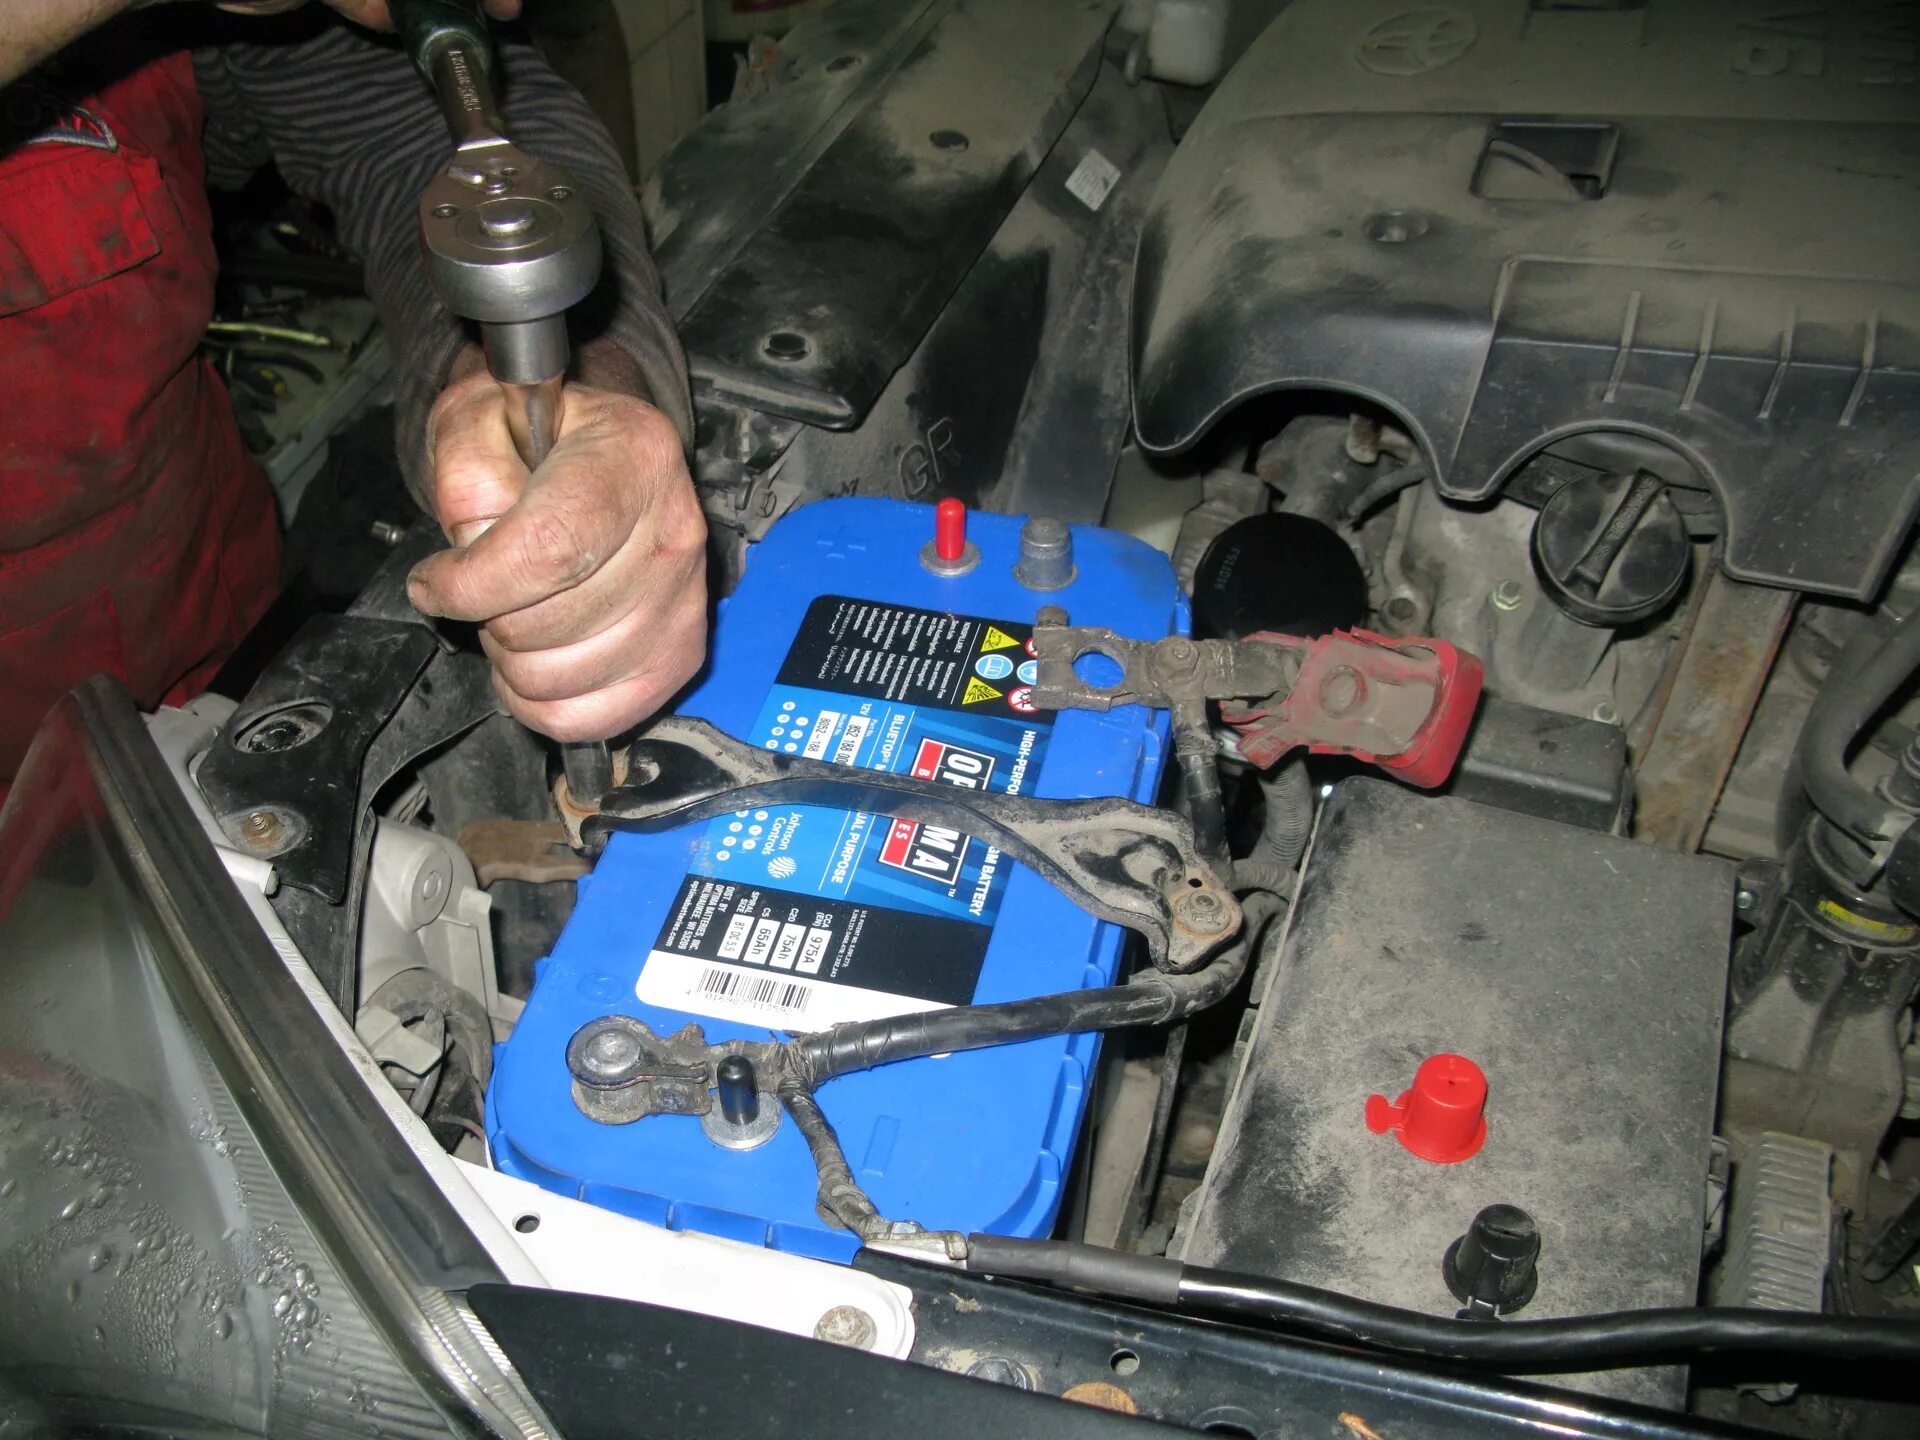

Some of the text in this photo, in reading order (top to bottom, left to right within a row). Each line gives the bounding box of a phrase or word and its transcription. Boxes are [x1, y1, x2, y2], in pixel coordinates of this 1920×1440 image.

[899, 417, 962, 500] GR
[859, 703, 871, 715] 12V
[815, 717, 830, 733] 8052
[845, 724, 861, 737] 852
[807, 741, 820, 751] 188
[839, 740, 854, 751] 188
[1006, 730, 1035, 794] HIGH-PERFO
[762, 817, 786, 854] Controls
[778, 812, 801, 850] Johnson
[831, 812, 866, 882] UAL PURPOSE
[717, 886, 735, 912] DIST. BY
[743, 891, 759, 913] SPIRAL
[969, 865, 994, 915] BATTERY
[665, 880, 699, 946] optimabatteries.com
[677, 882, 713, 949] MILWAUKEE, WI 53209
[688, 884, 724, 950] OPTIMA BATTERIES, INC.
[736, 898, 748, 912] SIZE
[787, 907, 798, 922] C20
[812, 911, 824, 926] (EN)
[821, 913, 832, 927] CCA
[751, 928, 771, 954] 65Ah
[778, 934, 796, 959] 75Ah
[802, 936, 822, 962] 975A
